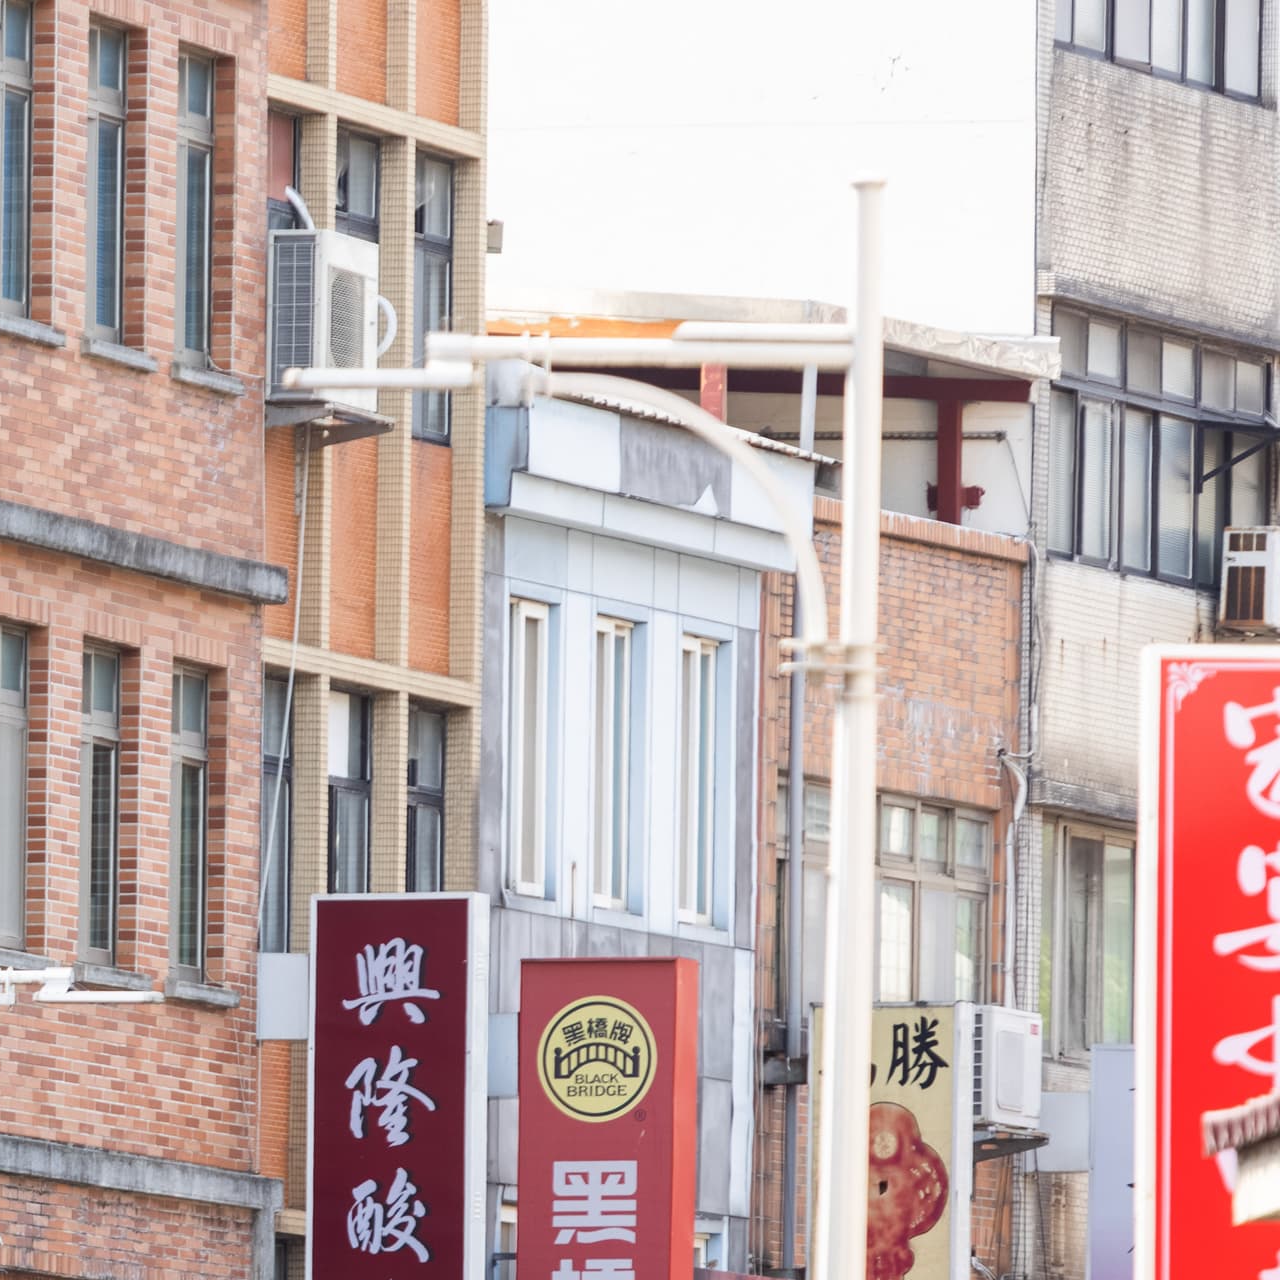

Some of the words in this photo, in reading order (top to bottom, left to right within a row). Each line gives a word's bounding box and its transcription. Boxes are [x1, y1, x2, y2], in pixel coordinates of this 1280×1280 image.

[562, 1018, 634, 1046] 黑橋牌
[575, 1073, 619, 1085] BLACK
[567, 1085, 628, 1097] BRIDGE
